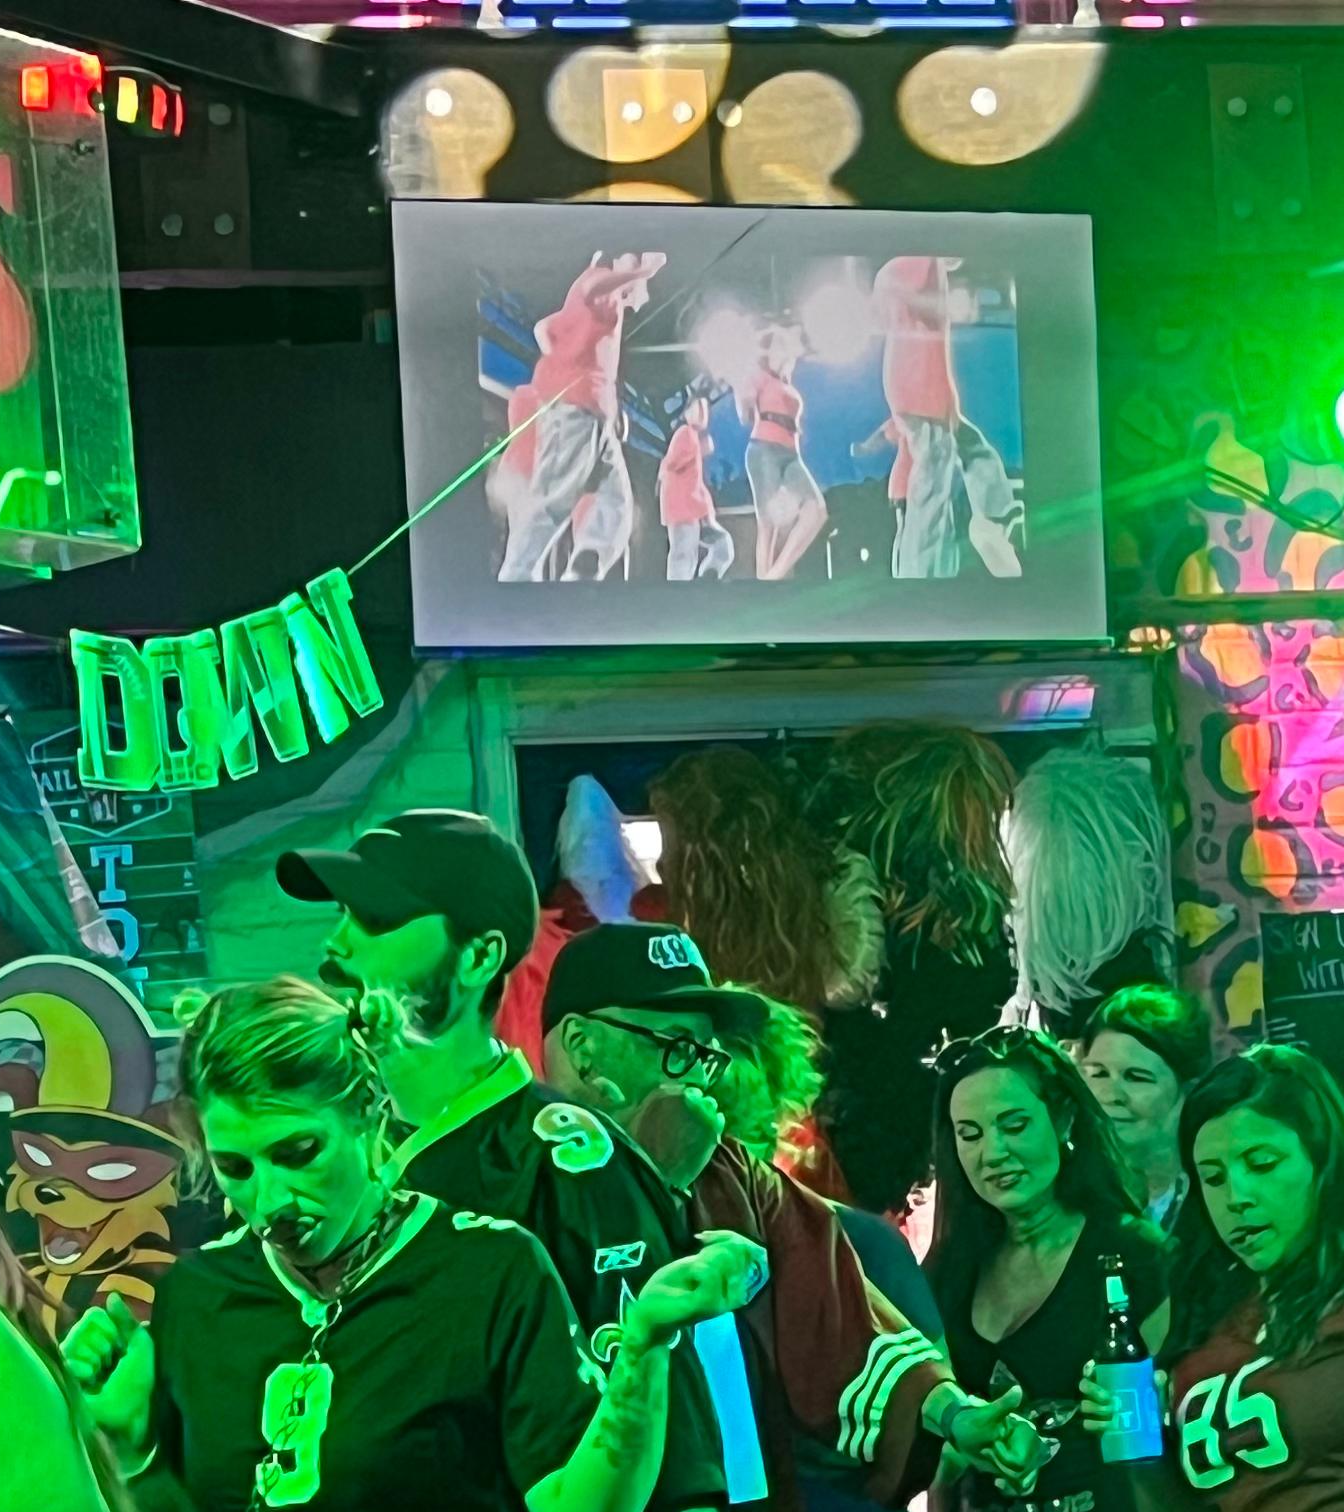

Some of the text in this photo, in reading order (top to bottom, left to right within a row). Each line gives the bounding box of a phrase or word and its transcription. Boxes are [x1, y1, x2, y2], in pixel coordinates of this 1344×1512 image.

[69, 566, 384, 793] DOWN
[256, 1362, 334, 1507] 9
[1176, 1355, 1289, 1490] 85
